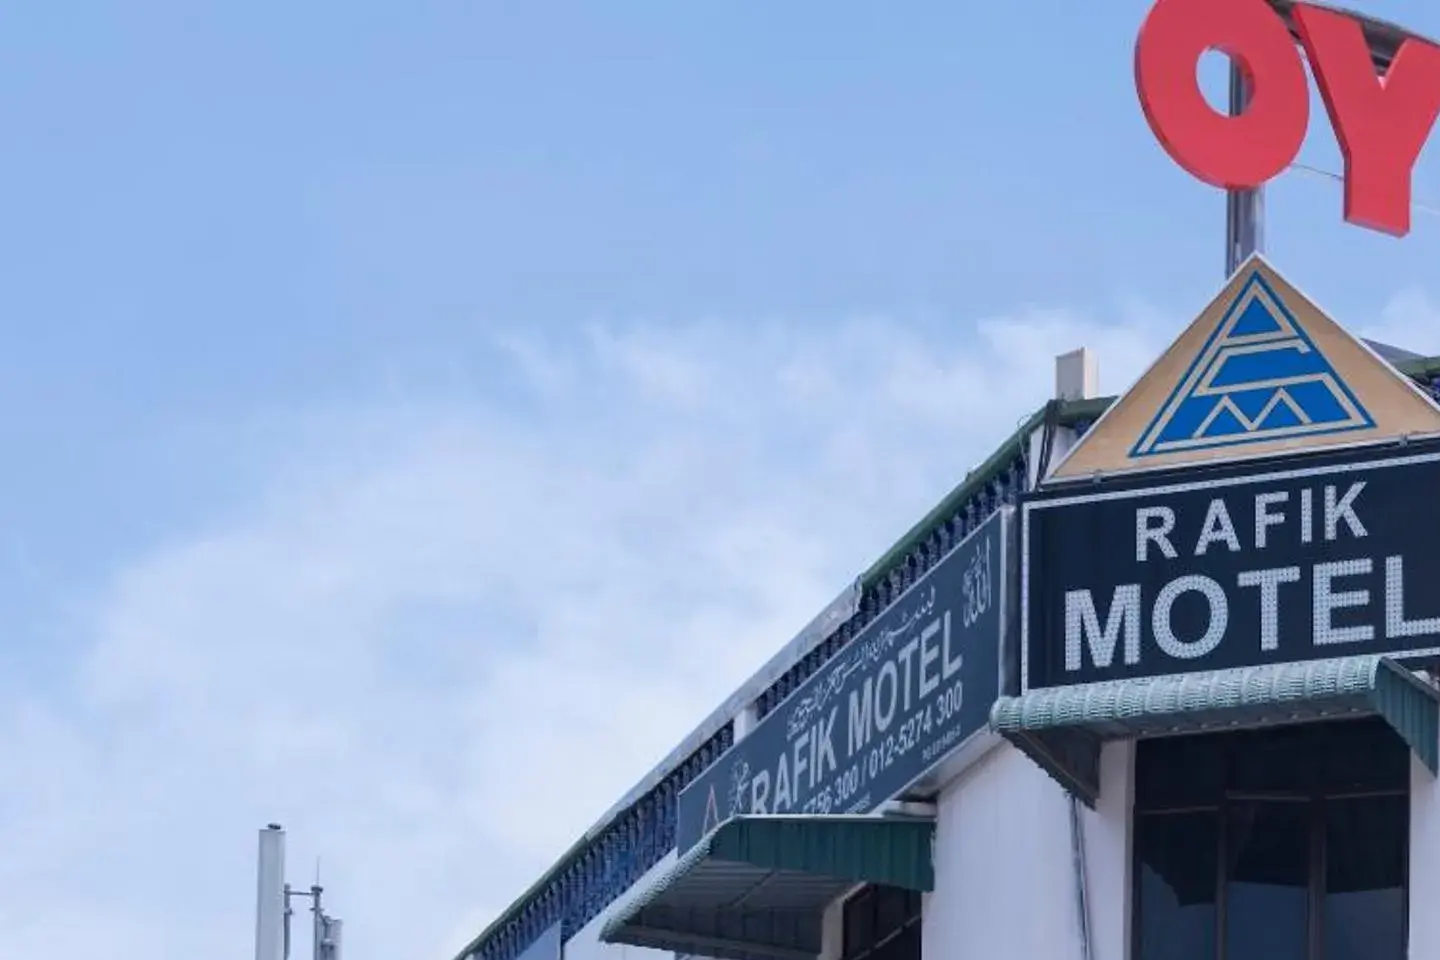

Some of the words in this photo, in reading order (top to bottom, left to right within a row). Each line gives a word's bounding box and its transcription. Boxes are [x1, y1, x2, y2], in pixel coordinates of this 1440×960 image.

[1134, 481, 1368, 562] RAFIK
[752, 706, 838, 814] RAFIK
[848, 611, 963, 757] MOTEL
[834, 765, 859, 807] 300
[868, 705, 933, 780] 012-5274
[936, 680, 963, 727] 300
